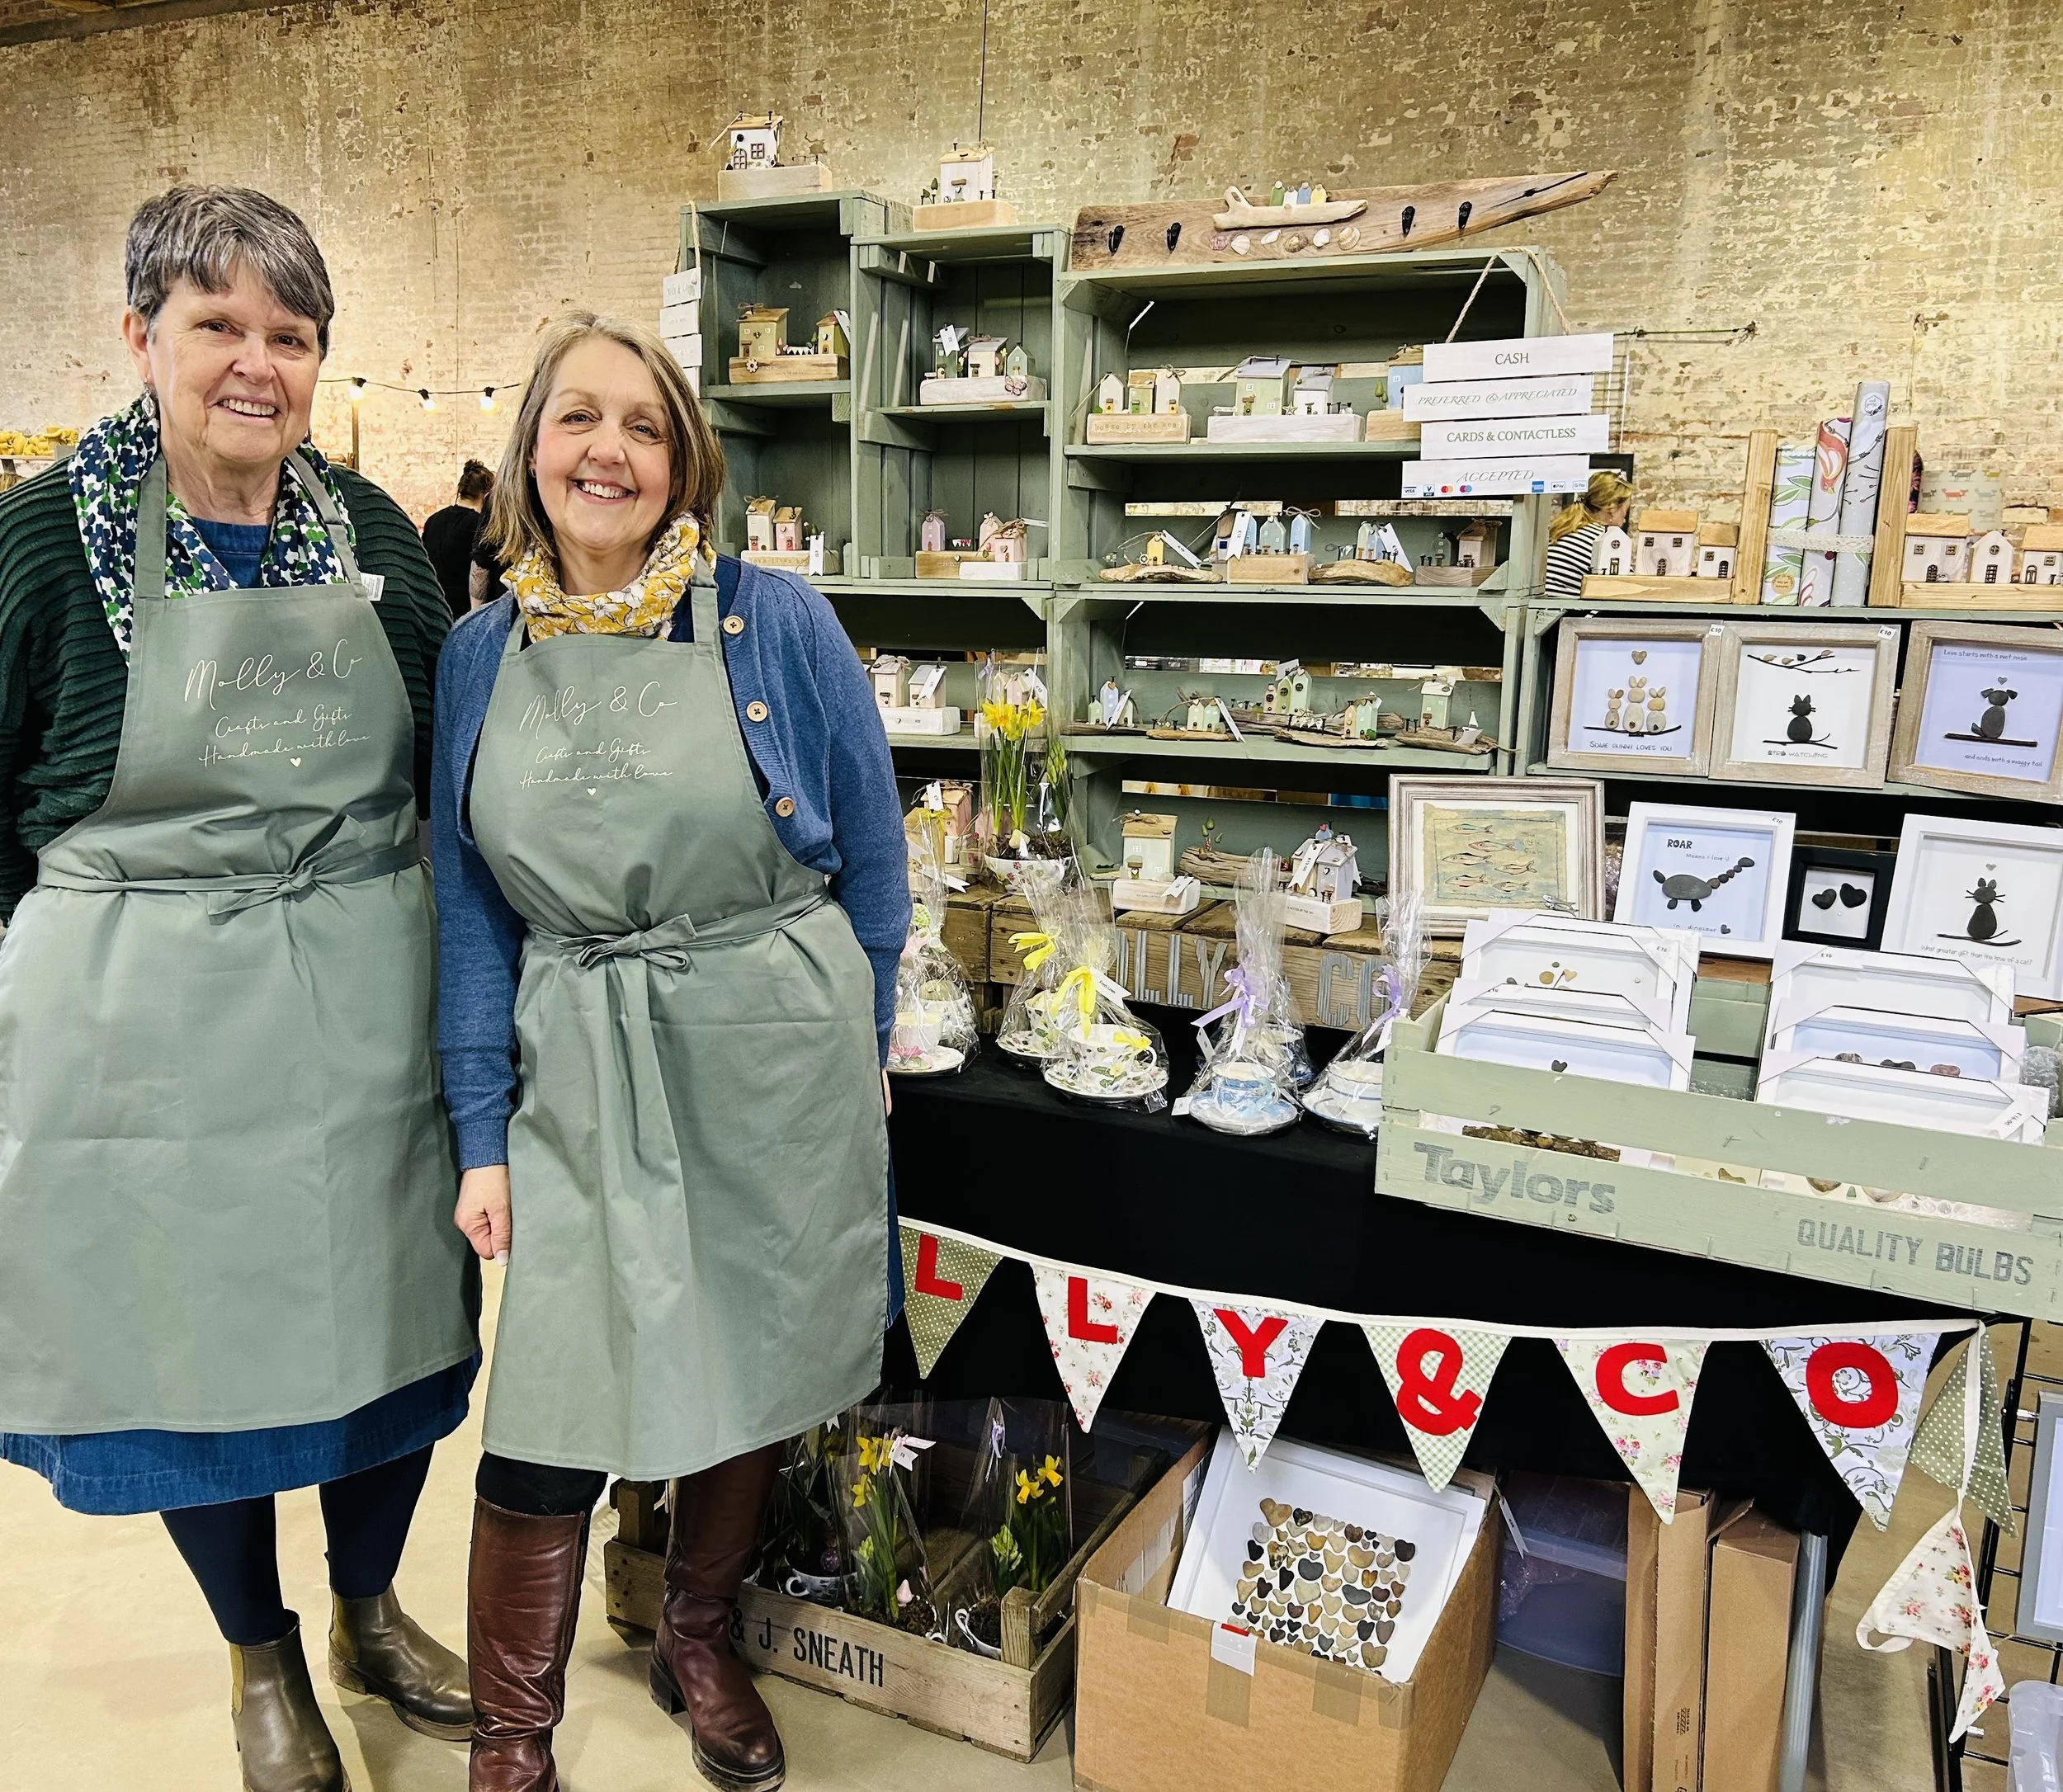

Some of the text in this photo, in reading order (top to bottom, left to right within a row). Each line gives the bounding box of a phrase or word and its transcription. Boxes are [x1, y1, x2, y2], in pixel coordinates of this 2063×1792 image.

[1494, 352, 1530, 365] CASH
[1417, 394, 1481, 406] PREFERRED
[1498, 388, 1578, 402] APPRECIATED
[1447, 427, 1576, 442] CARDS & CONTACTLESS
[1456, 469, 1534, 483] ACCEPTED
[184, 639, 363, 711] Molly & Co
[215, 704, 352, 738] Crafts and Gifts
[519, 681, 678, 739] Molly & Co
[199, 729, 371, 767] Handmade with love
[536, 738, 651, 764] Crafts and Gifts
[519, 762, 673, 790] Handmade with love
[1667, 838, 1693, 850] ROAR
[1994, 954, 2006, 962] love
[1413, 1141, 1616, 1214] Taylors
[1797, 1218, 2034, 1285] QUALITY BULBS
[729, 1607, 884, 1688] & J. SNEATH
